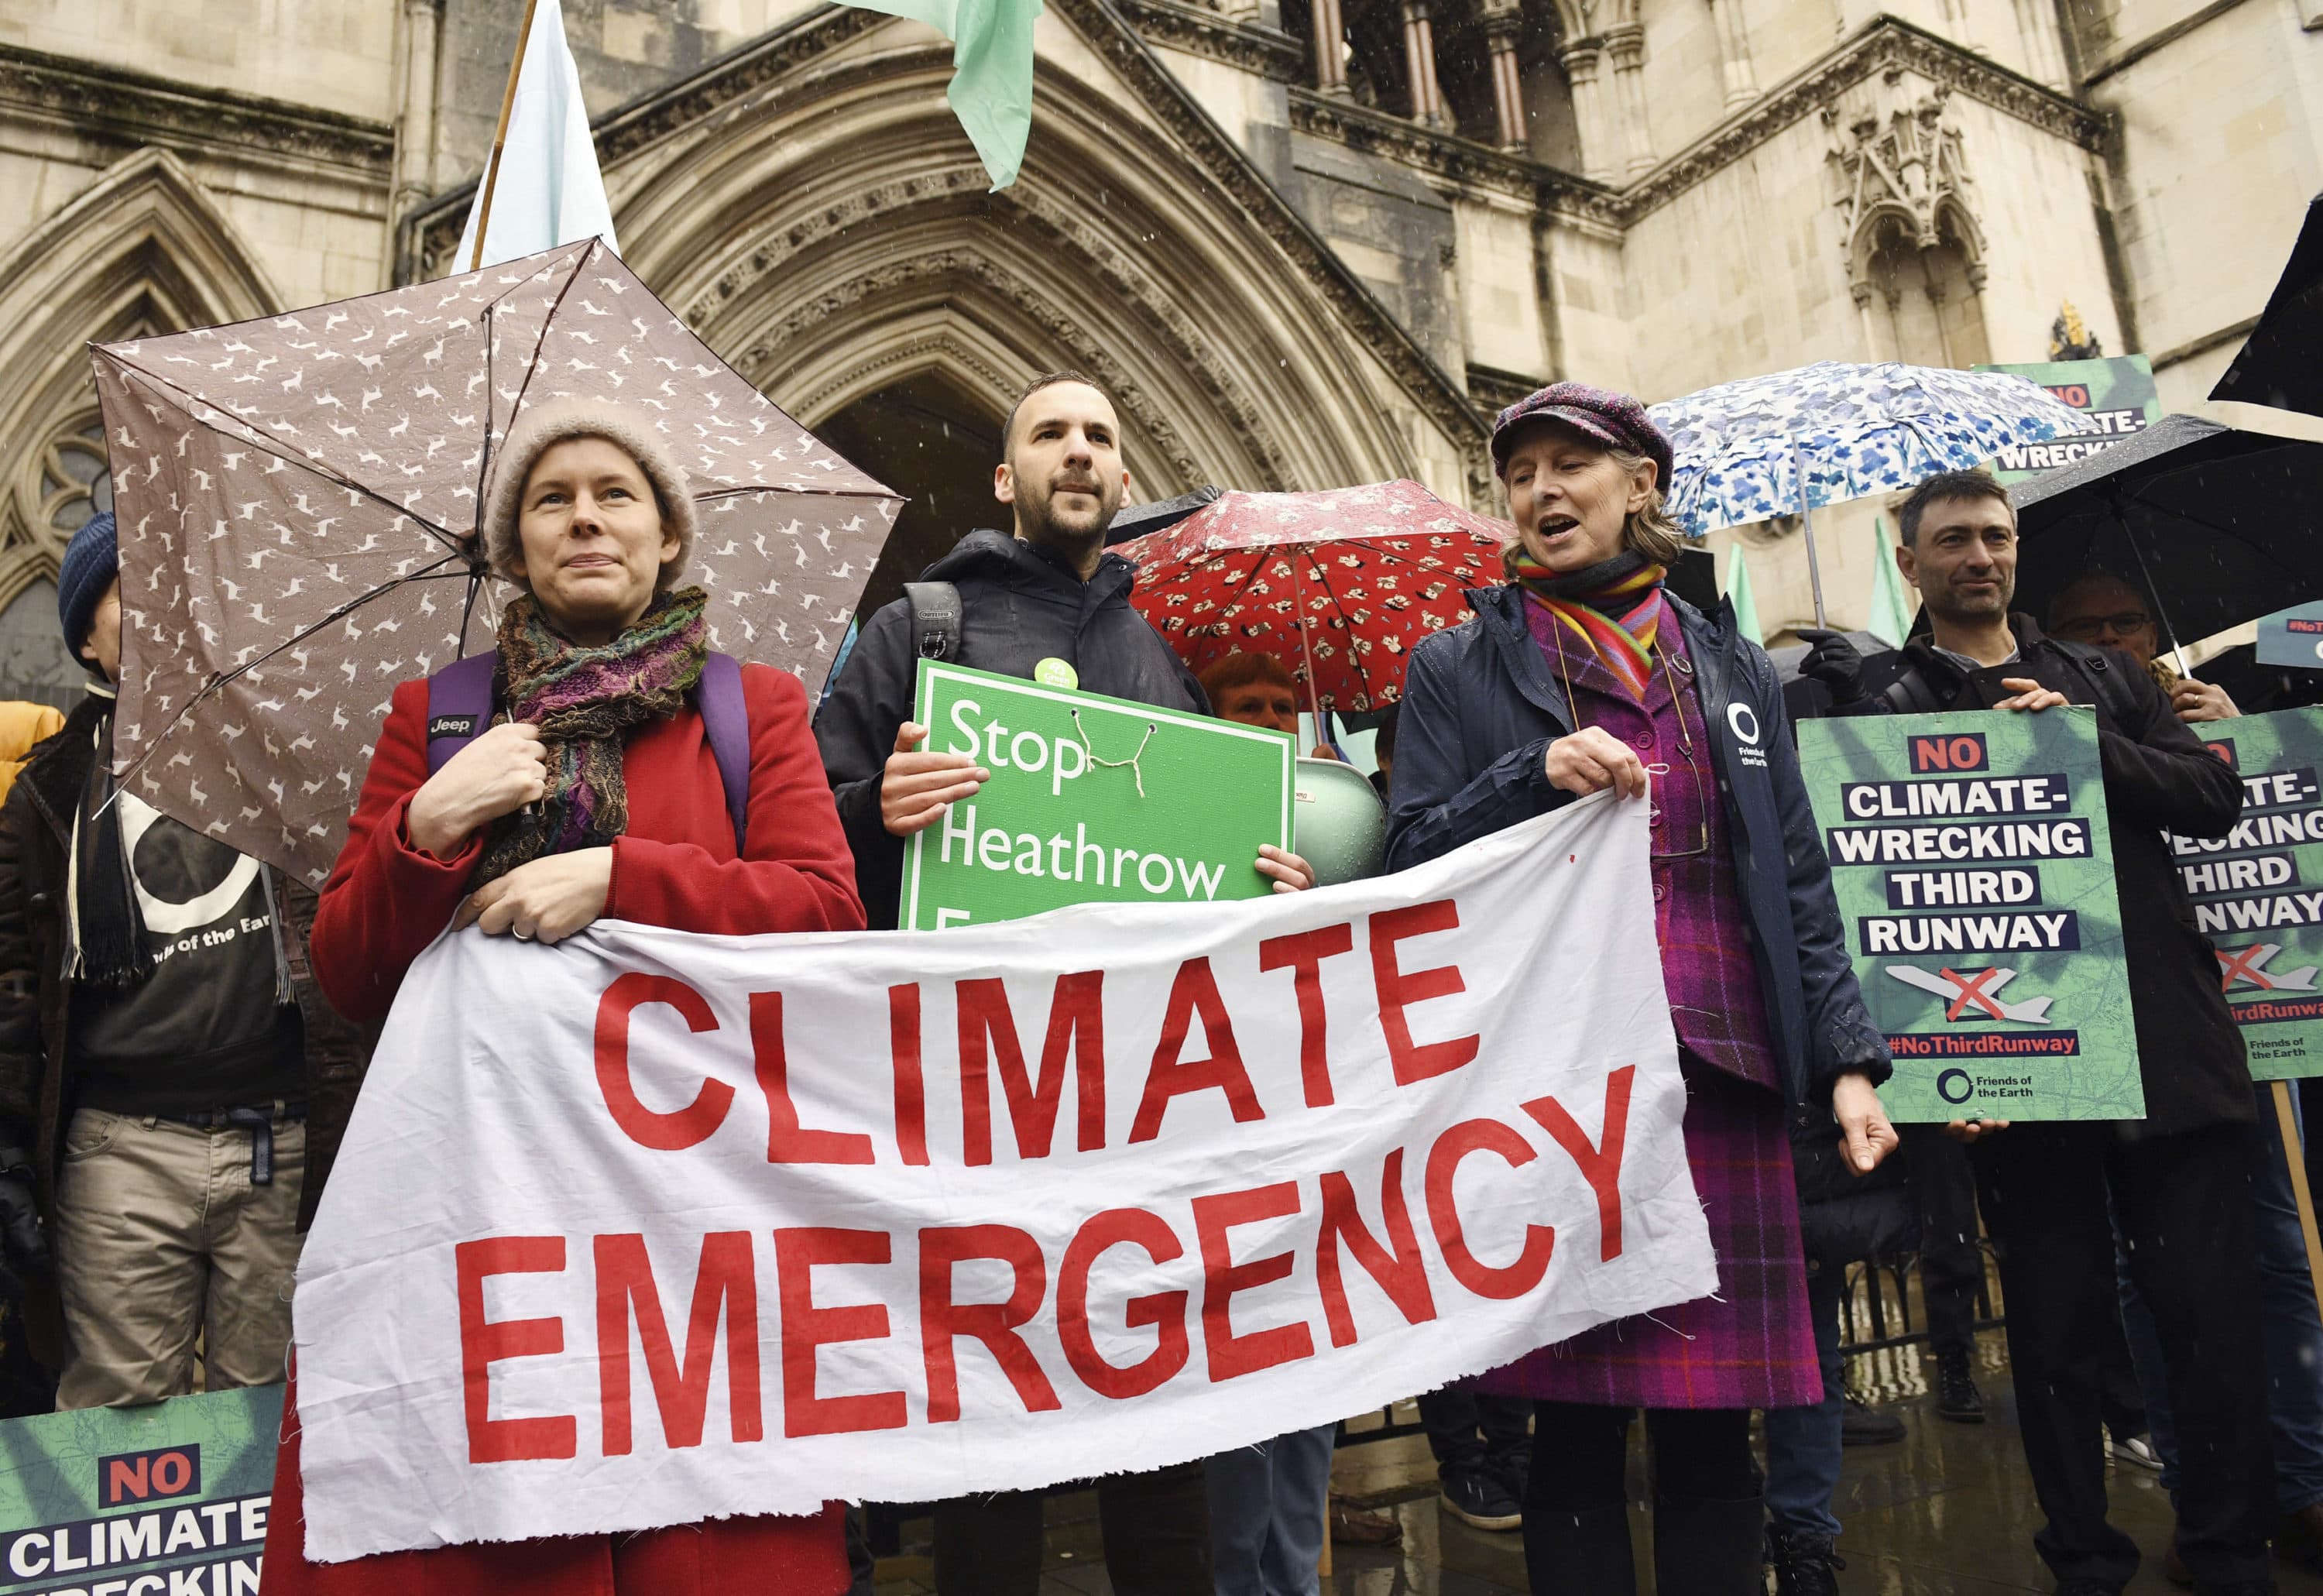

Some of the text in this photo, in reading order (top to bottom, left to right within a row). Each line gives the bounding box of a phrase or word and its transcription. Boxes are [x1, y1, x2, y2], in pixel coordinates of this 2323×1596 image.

[431, 719, 470, 733] Jeep
[949, 699, 1086, 795] Stop
[1918, 738, 1981, 770] NO
[1848, 779, 2067, 818] CLIMATE-
[940, 804, 1227, 901] Heathrow
[1833, 821, 2085, 861] WRECKING
[1892, 870, 2034, 904] THIRD
[2177, 856, 2292, 894] HIRD
[177, 935, 199, 952] of
[202, 928, 236, 947] the
[1867, 913, 2067, 951] RUNWAY
[595, 898, 1480, 1168] CLIMATE
[1889, 1035, 2075, 1055] #NoThirdRunway
[2249, 1037, 2304, 1049] Friends of
[2252, 1049, 2307, 1059] the Earth
[1976, 1076, 2033, 1086] Friends of
[1978, 1087, 2033, 1097] the Earth
[455, 1065, 1635, 1464] EMERGENCY
[110, 1452, 192, 1502] NO
